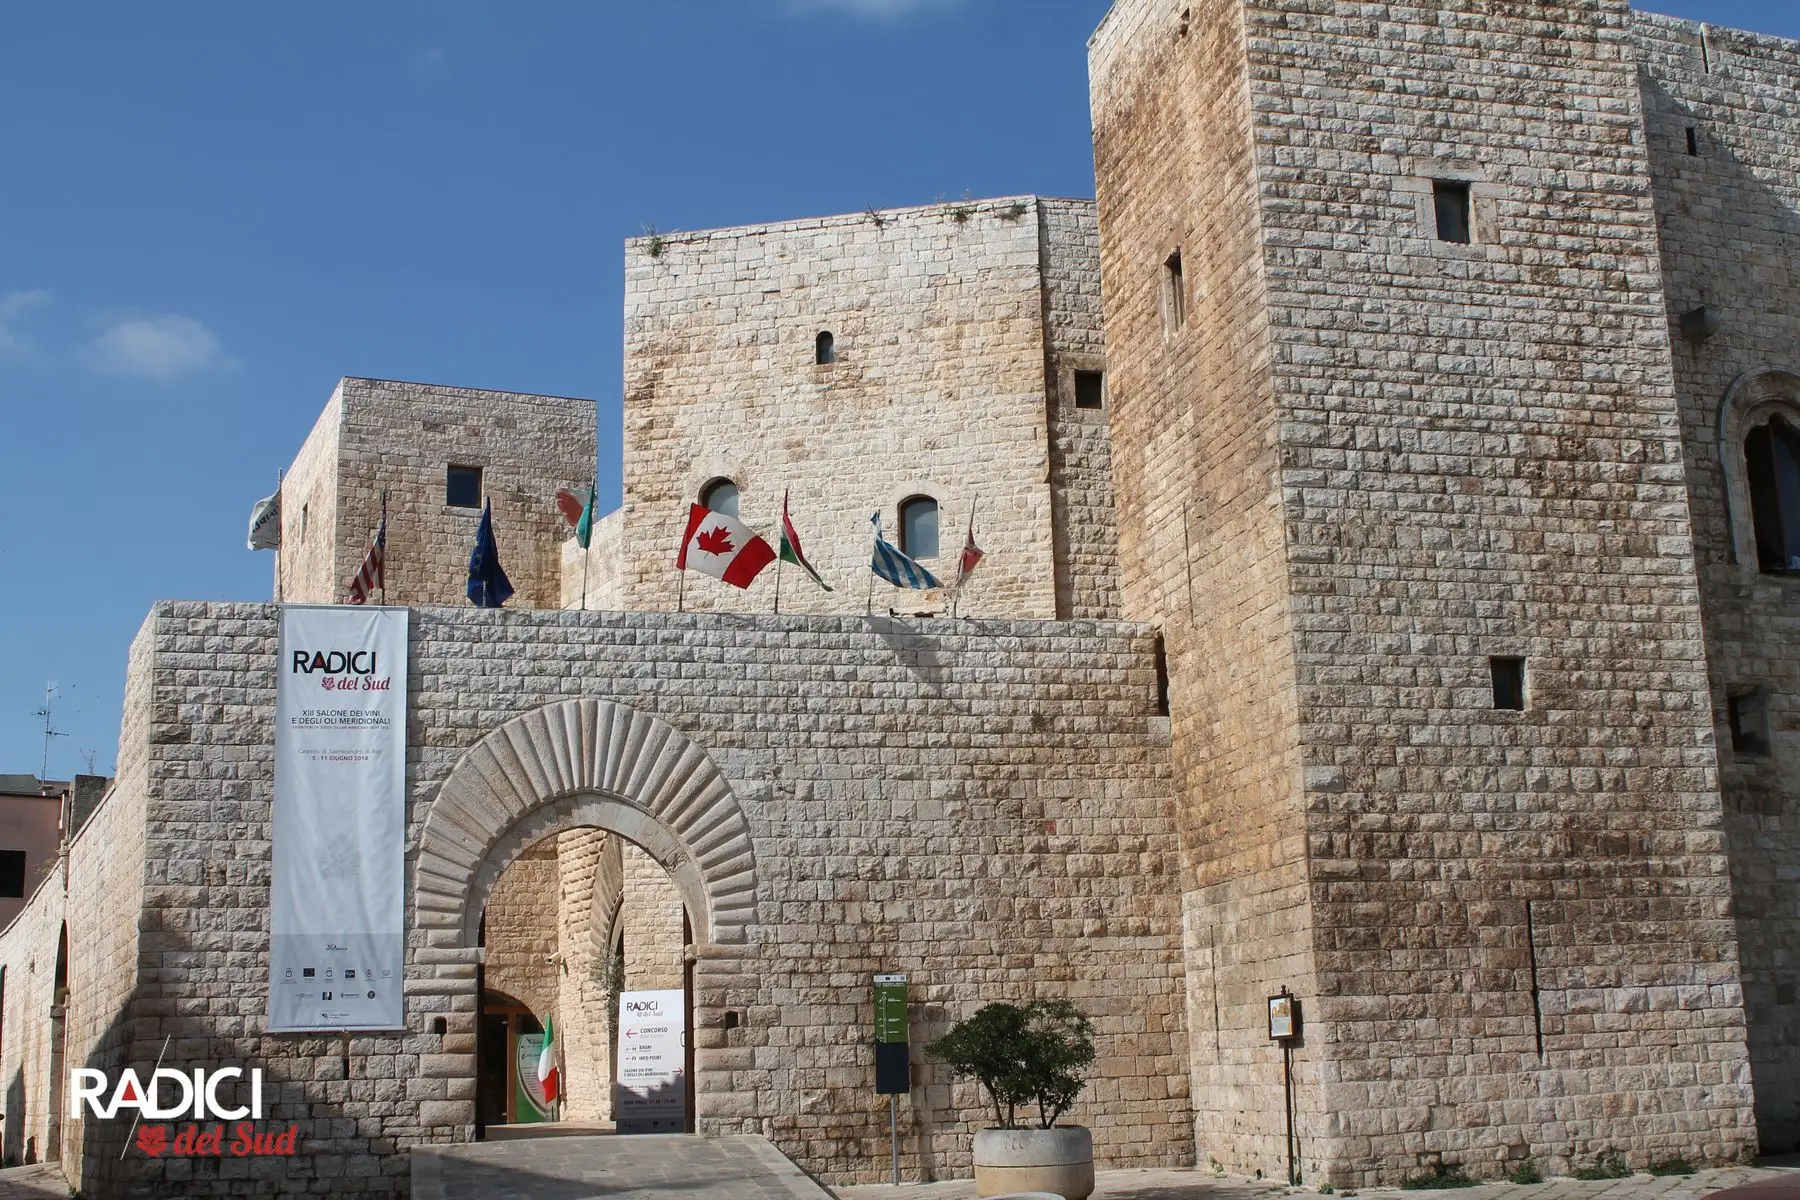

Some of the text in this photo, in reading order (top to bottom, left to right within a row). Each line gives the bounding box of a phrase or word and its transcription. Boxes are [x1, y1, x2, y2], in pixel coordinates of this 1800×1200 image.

[293, 650, 376, 674] RADICI
[337, 676, 391, 691] del Sud
[291, 717, 391, 725] E DEGLI OLI MERIDIONALI
[626, 1001, 658, 1011] RADICI
[640, 1026, 668, 1034] CONCORSO
